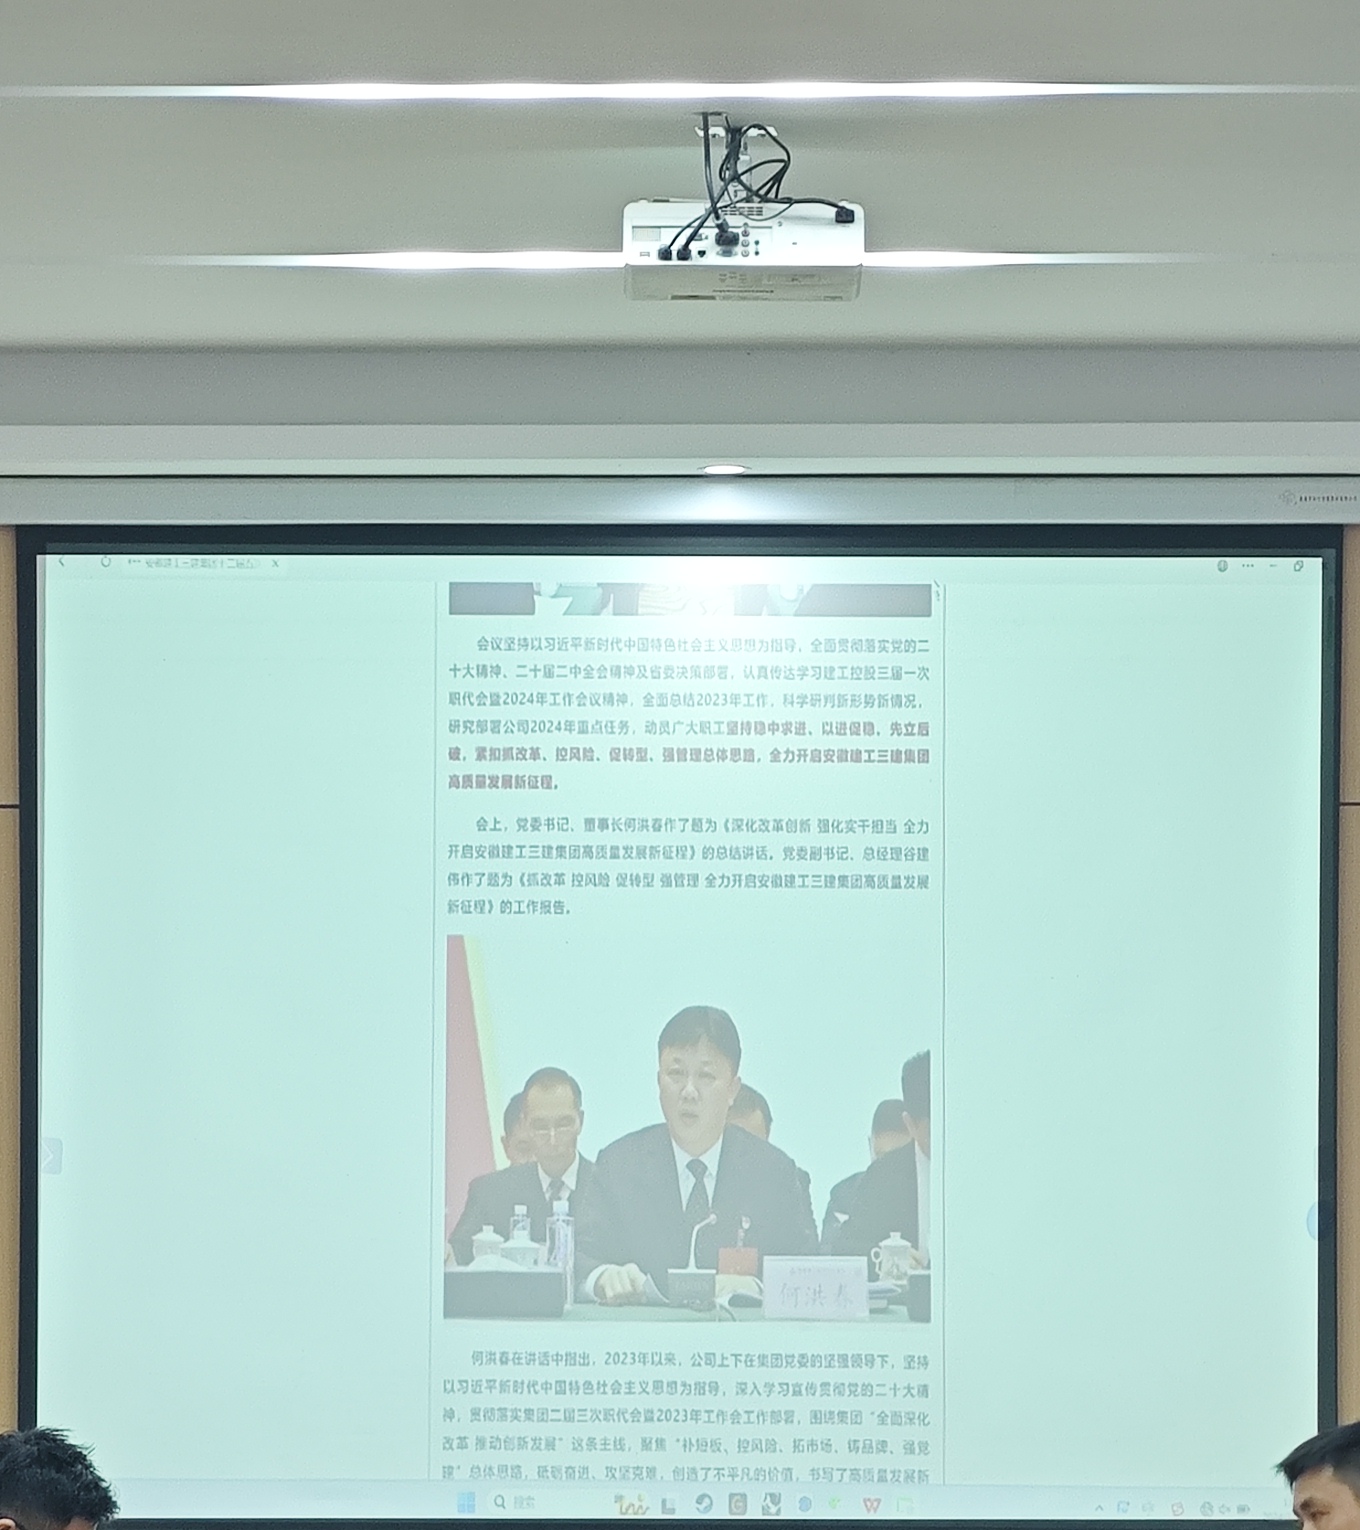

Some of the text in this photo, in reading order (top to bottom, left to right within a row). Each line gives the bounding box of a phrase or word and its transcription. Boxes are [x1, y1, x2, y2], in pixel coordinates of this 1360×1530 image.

[903, 819, 930, 834] 全力
[571, 872, 610, 888] 控风险
[616, 872, 655, 888] 促转型
[660, 872, 700, 889] 强管理
[442, 1436, 469, 1452] 改革
